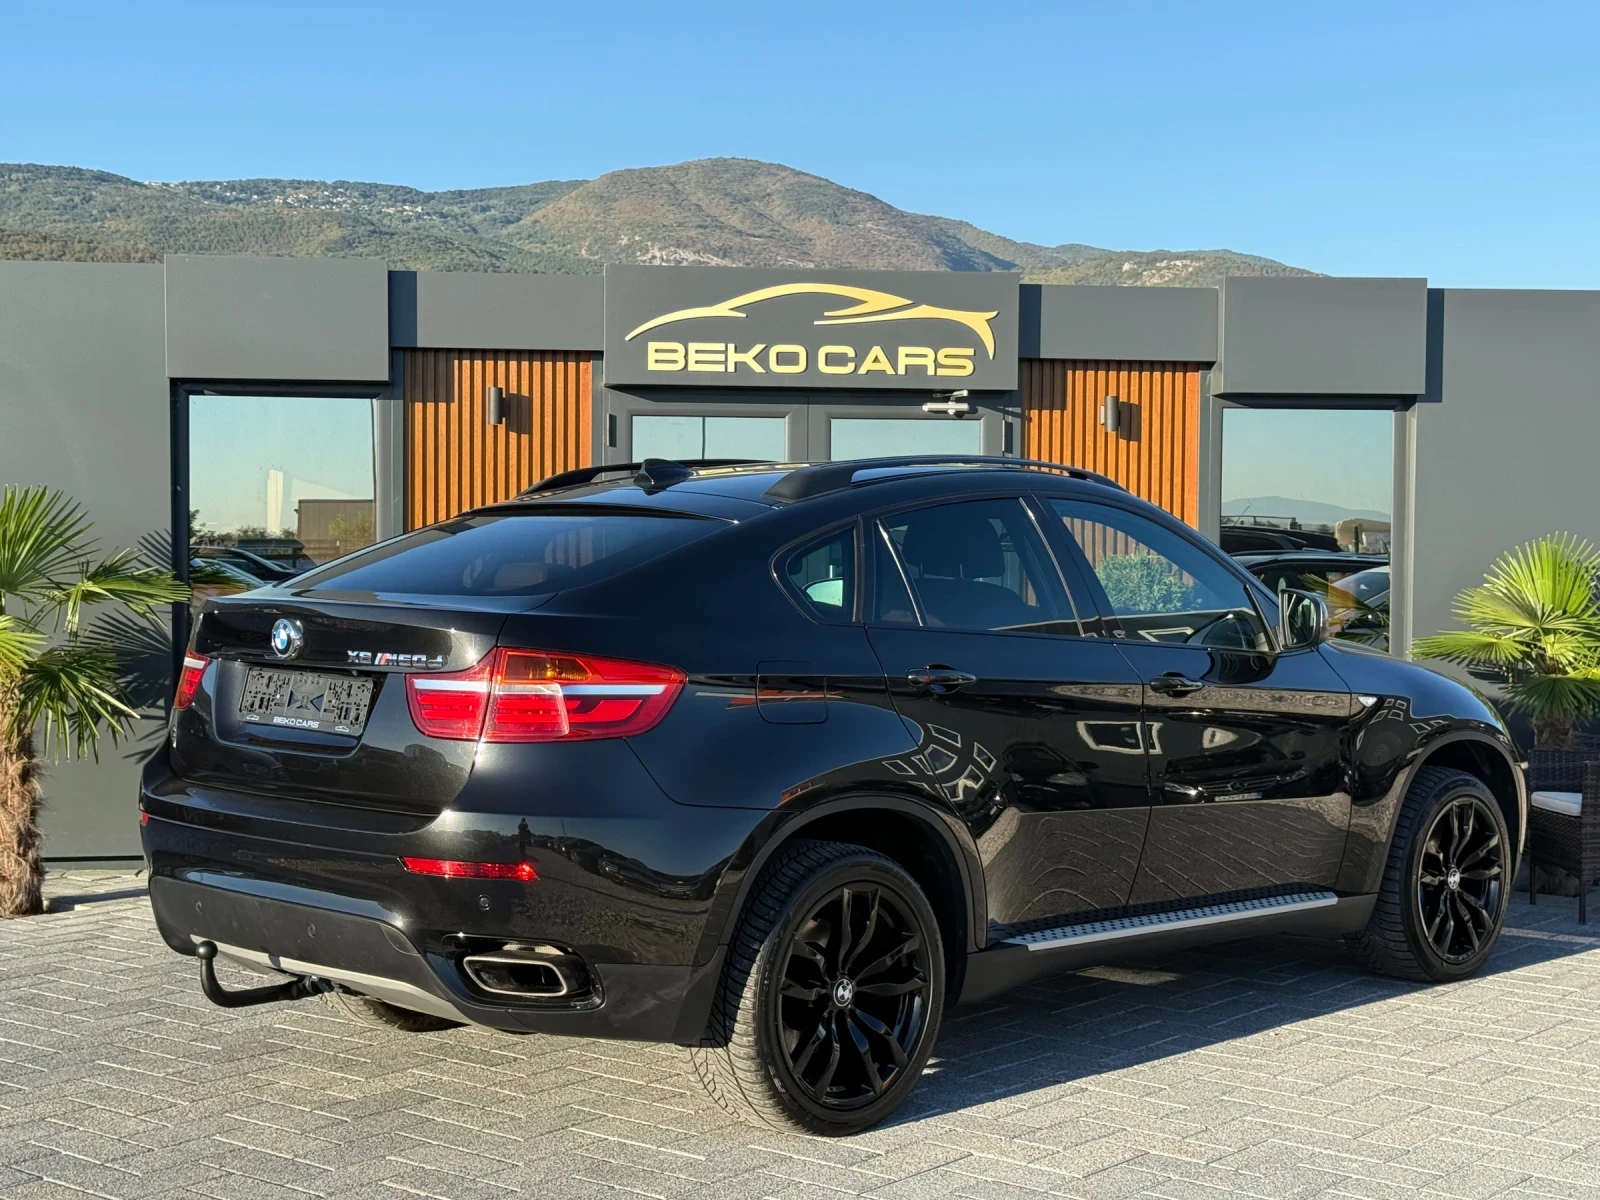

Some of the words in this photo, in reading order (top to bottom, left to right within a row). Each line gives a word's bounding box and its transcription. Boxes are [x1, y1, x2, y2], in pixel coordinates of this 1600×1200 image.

[647, 341, 808, 374] BEKO
[817, 345, 975, 377] CARS
[273, 716, 295, 725] BEKO
[296, 719, 320, 729] CARS
